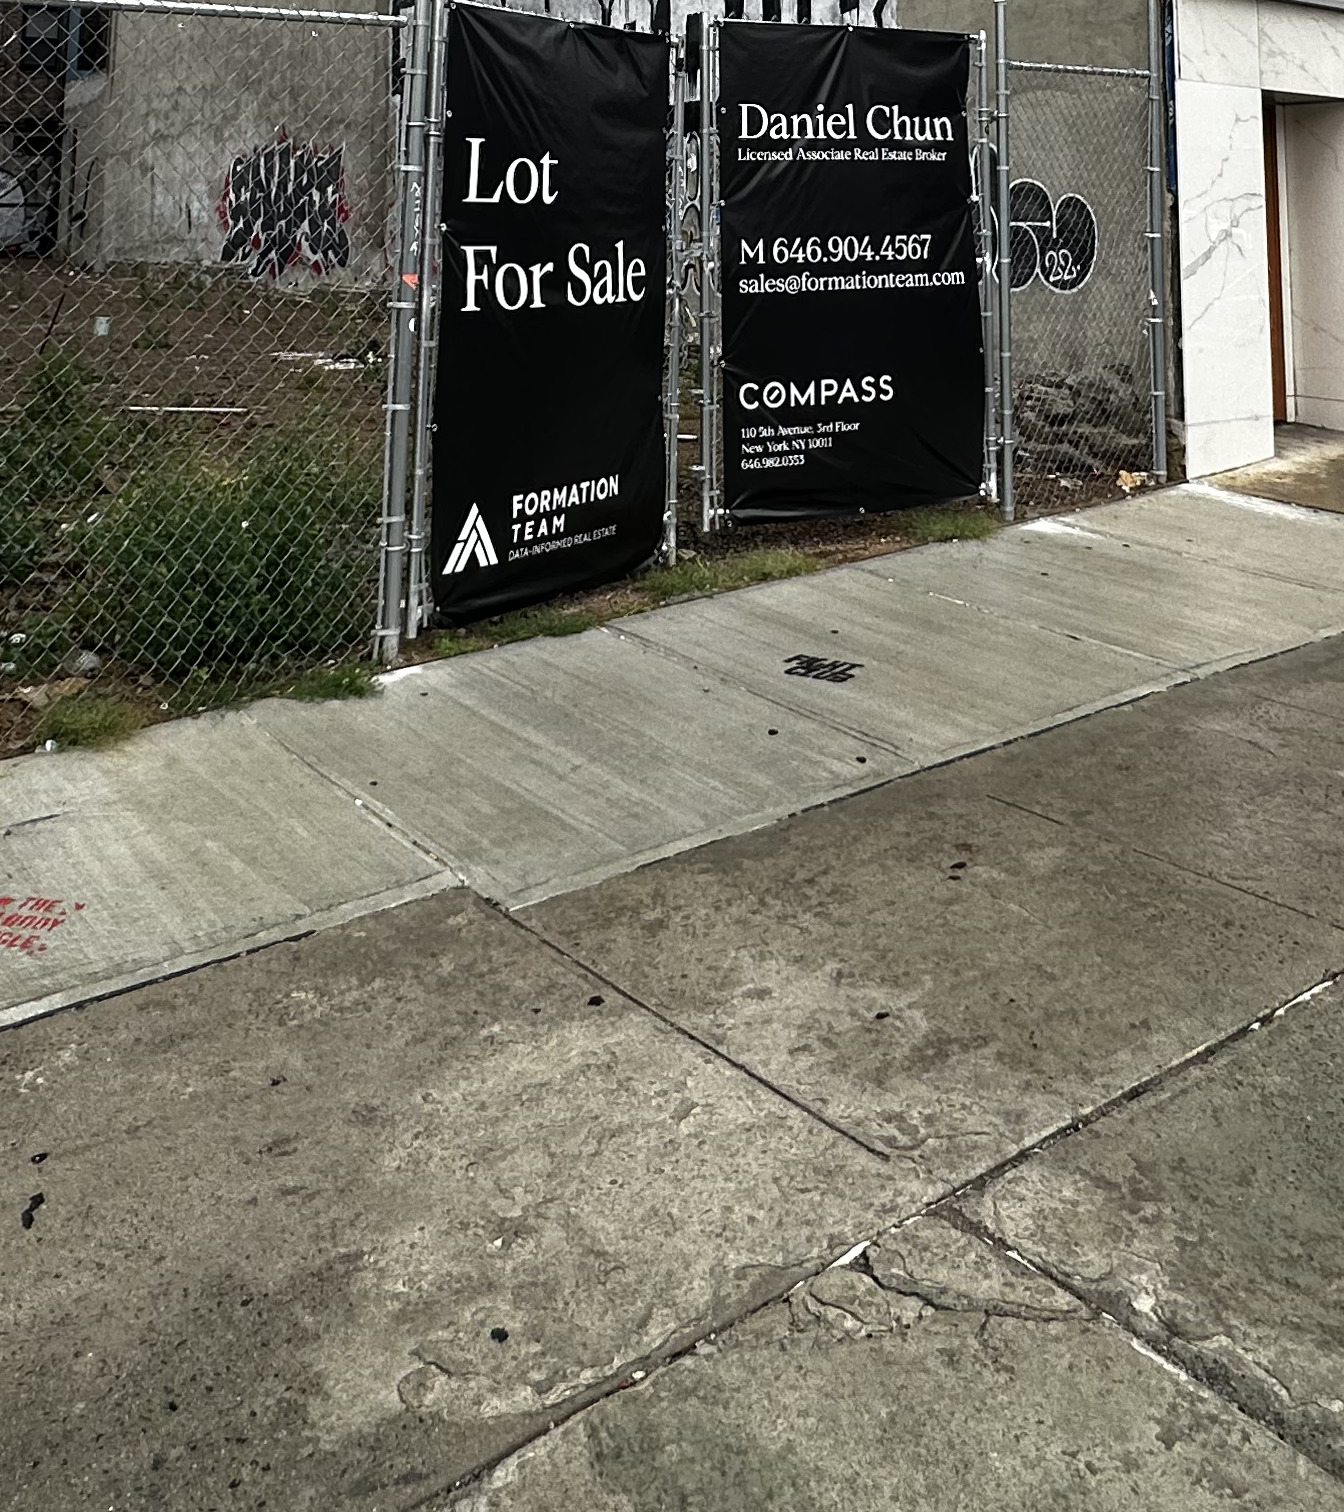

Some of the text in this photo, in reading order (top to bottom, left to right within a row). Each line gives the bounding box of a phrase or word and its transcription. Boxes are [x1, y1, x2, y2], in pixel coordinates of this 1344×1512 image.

[738, 103, 955, 141] Daniel Chun
[737, 148, 948, 162] Licensed Associate Real Estate Broker
[461, 137, 559, 205] Lot
[739, 234, 932, 265] M 646.904.4567
[460, 240, 646, 312] For Sale
[739, 270, 966, 294] sales@formationteam.com
[739, 375, 894, 410] COMPASS
[741, 427, 756, 438] 110
[816, 422, 833, 433] 3rd
[835, 421, 860, 432] Floor
[741, 437, 832, 454] New York NY 10011
[512, 474, 620, 518] FORMATION
[508, 524, 617, 561] DATA-INFORMED REAL ESTATE
[511, 513, 566, 543] TEAM
[18, 897, 64, 913] THE
